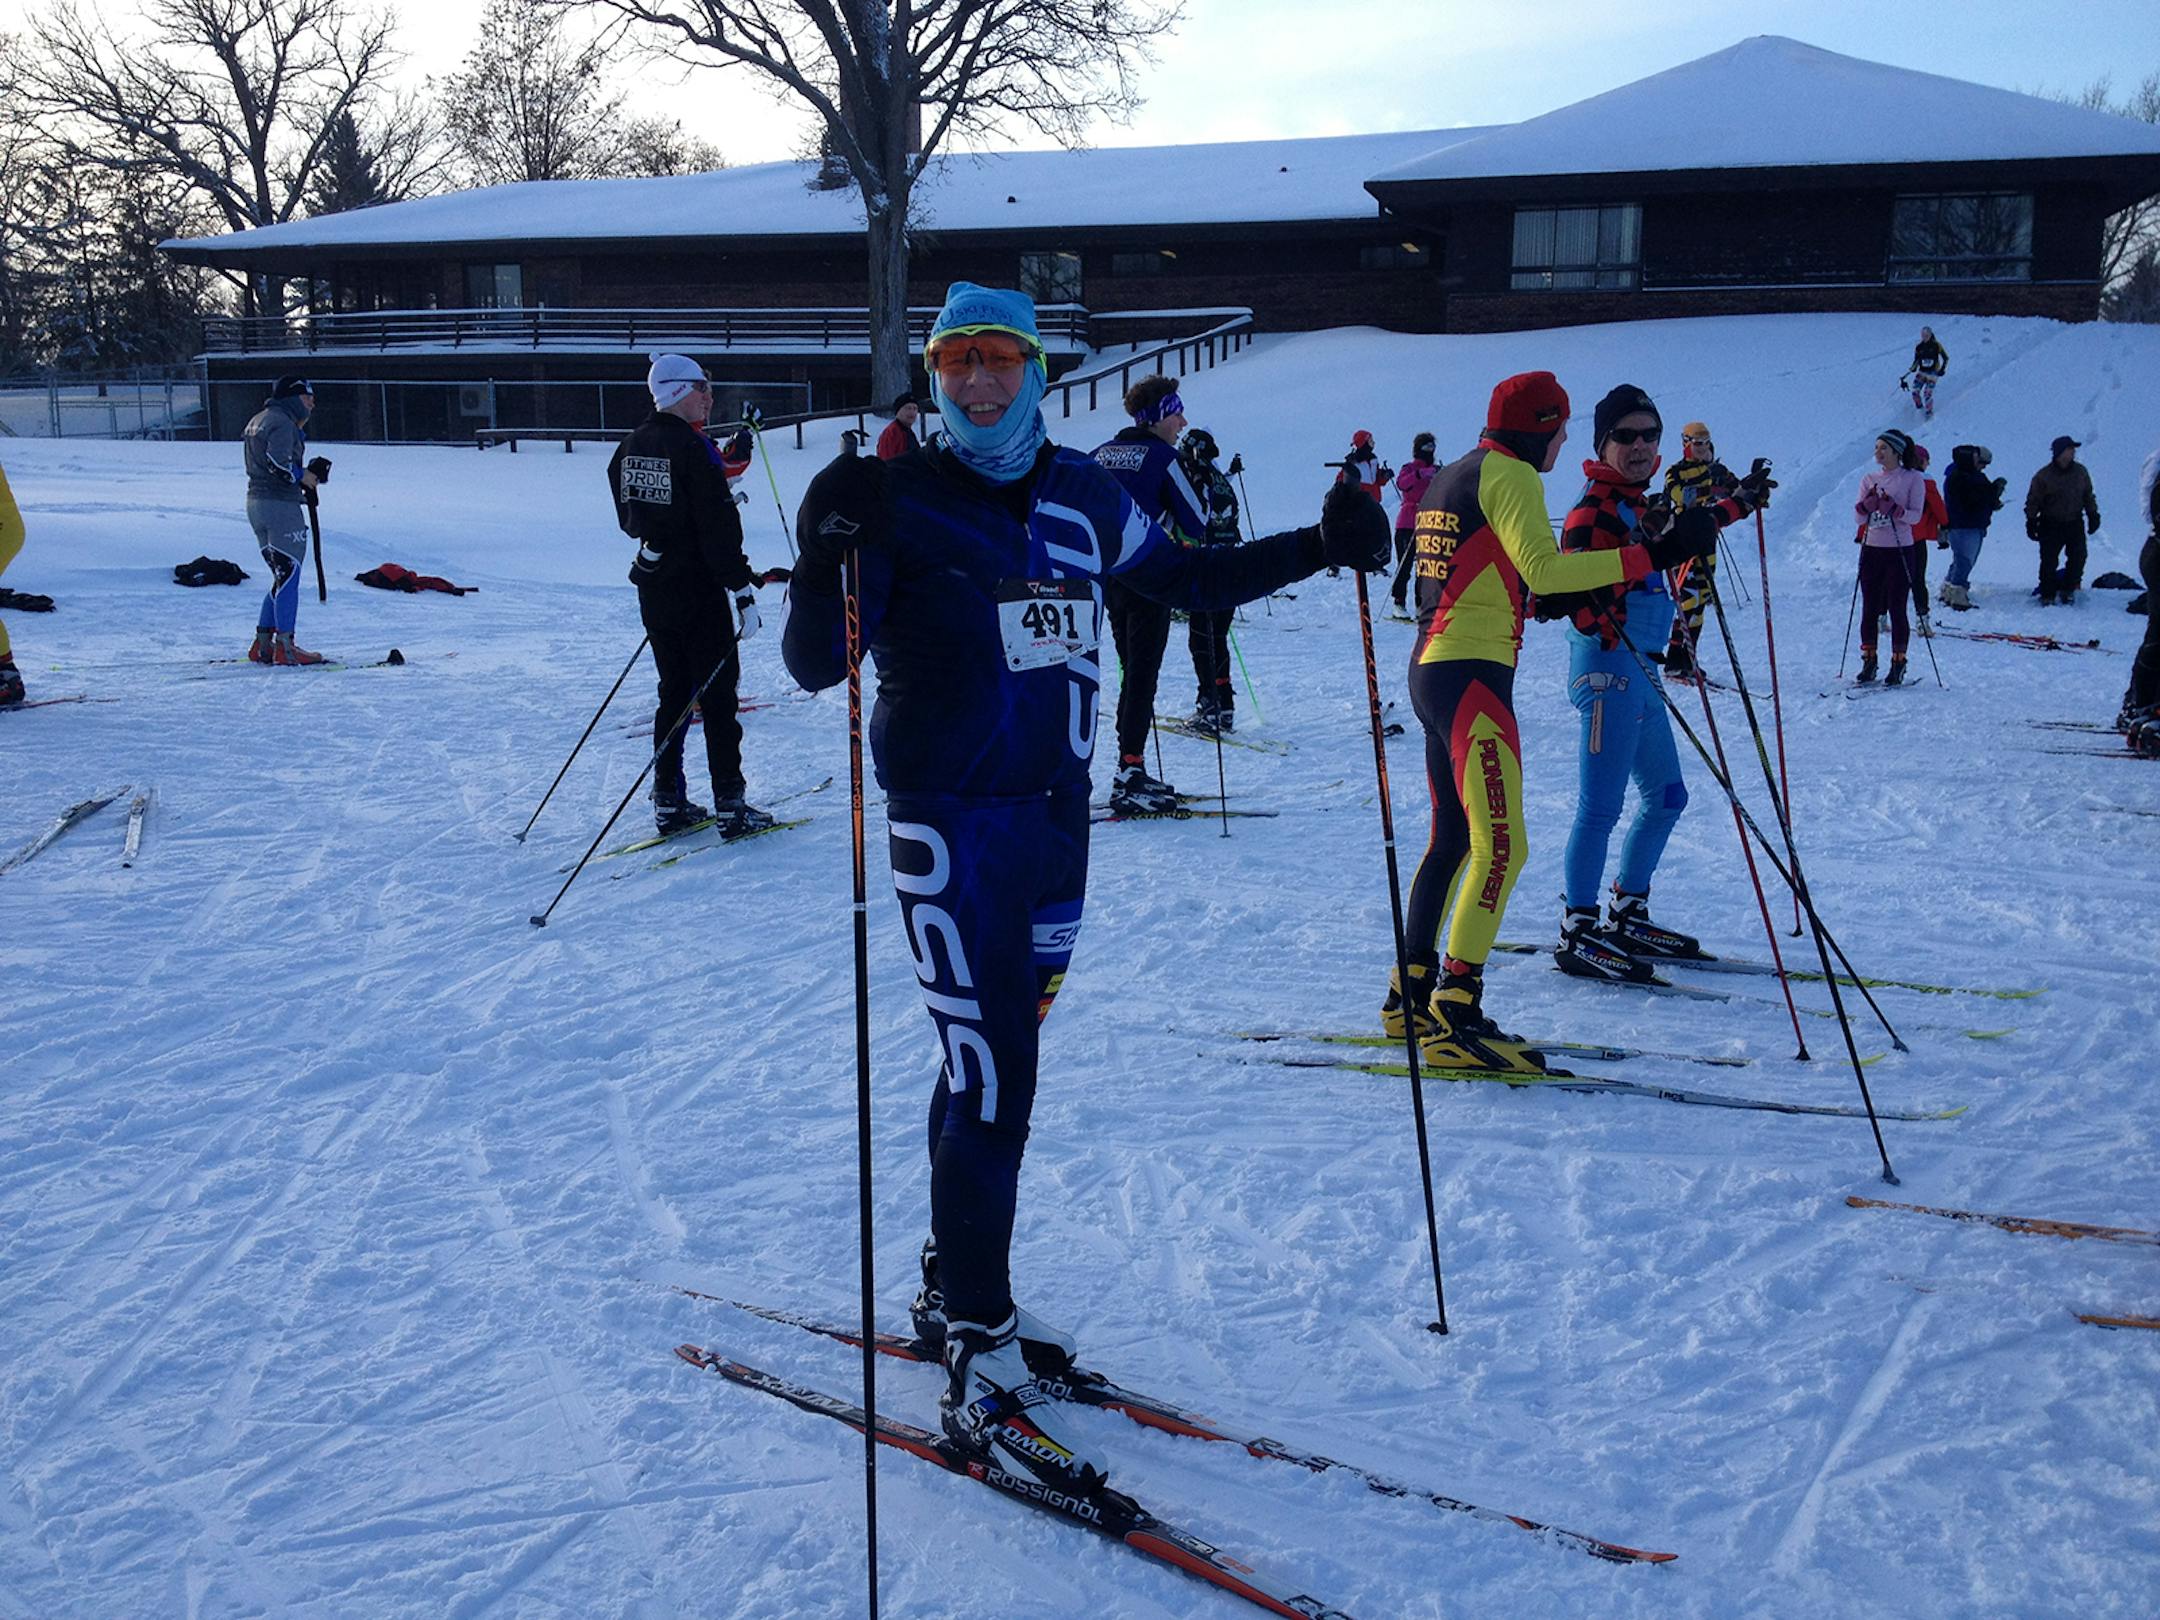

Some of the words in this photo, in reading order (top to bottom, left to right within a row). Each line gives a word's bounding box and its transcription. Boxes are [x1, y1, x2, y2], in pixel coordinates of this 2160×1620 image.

[635, 487, 670, 502] TEAM
[1021, 602, 1079, 639] 491
[1477, 738, 1508, 820] PIONEER
[1477, 822, 1511, 915] MIDWEST
[1633, 932, 1686, 949] SALOMON
[1582, 952, 1634, 971] SALOMON
[985, 1465, 1104, 1526] ROSSIGNOL
